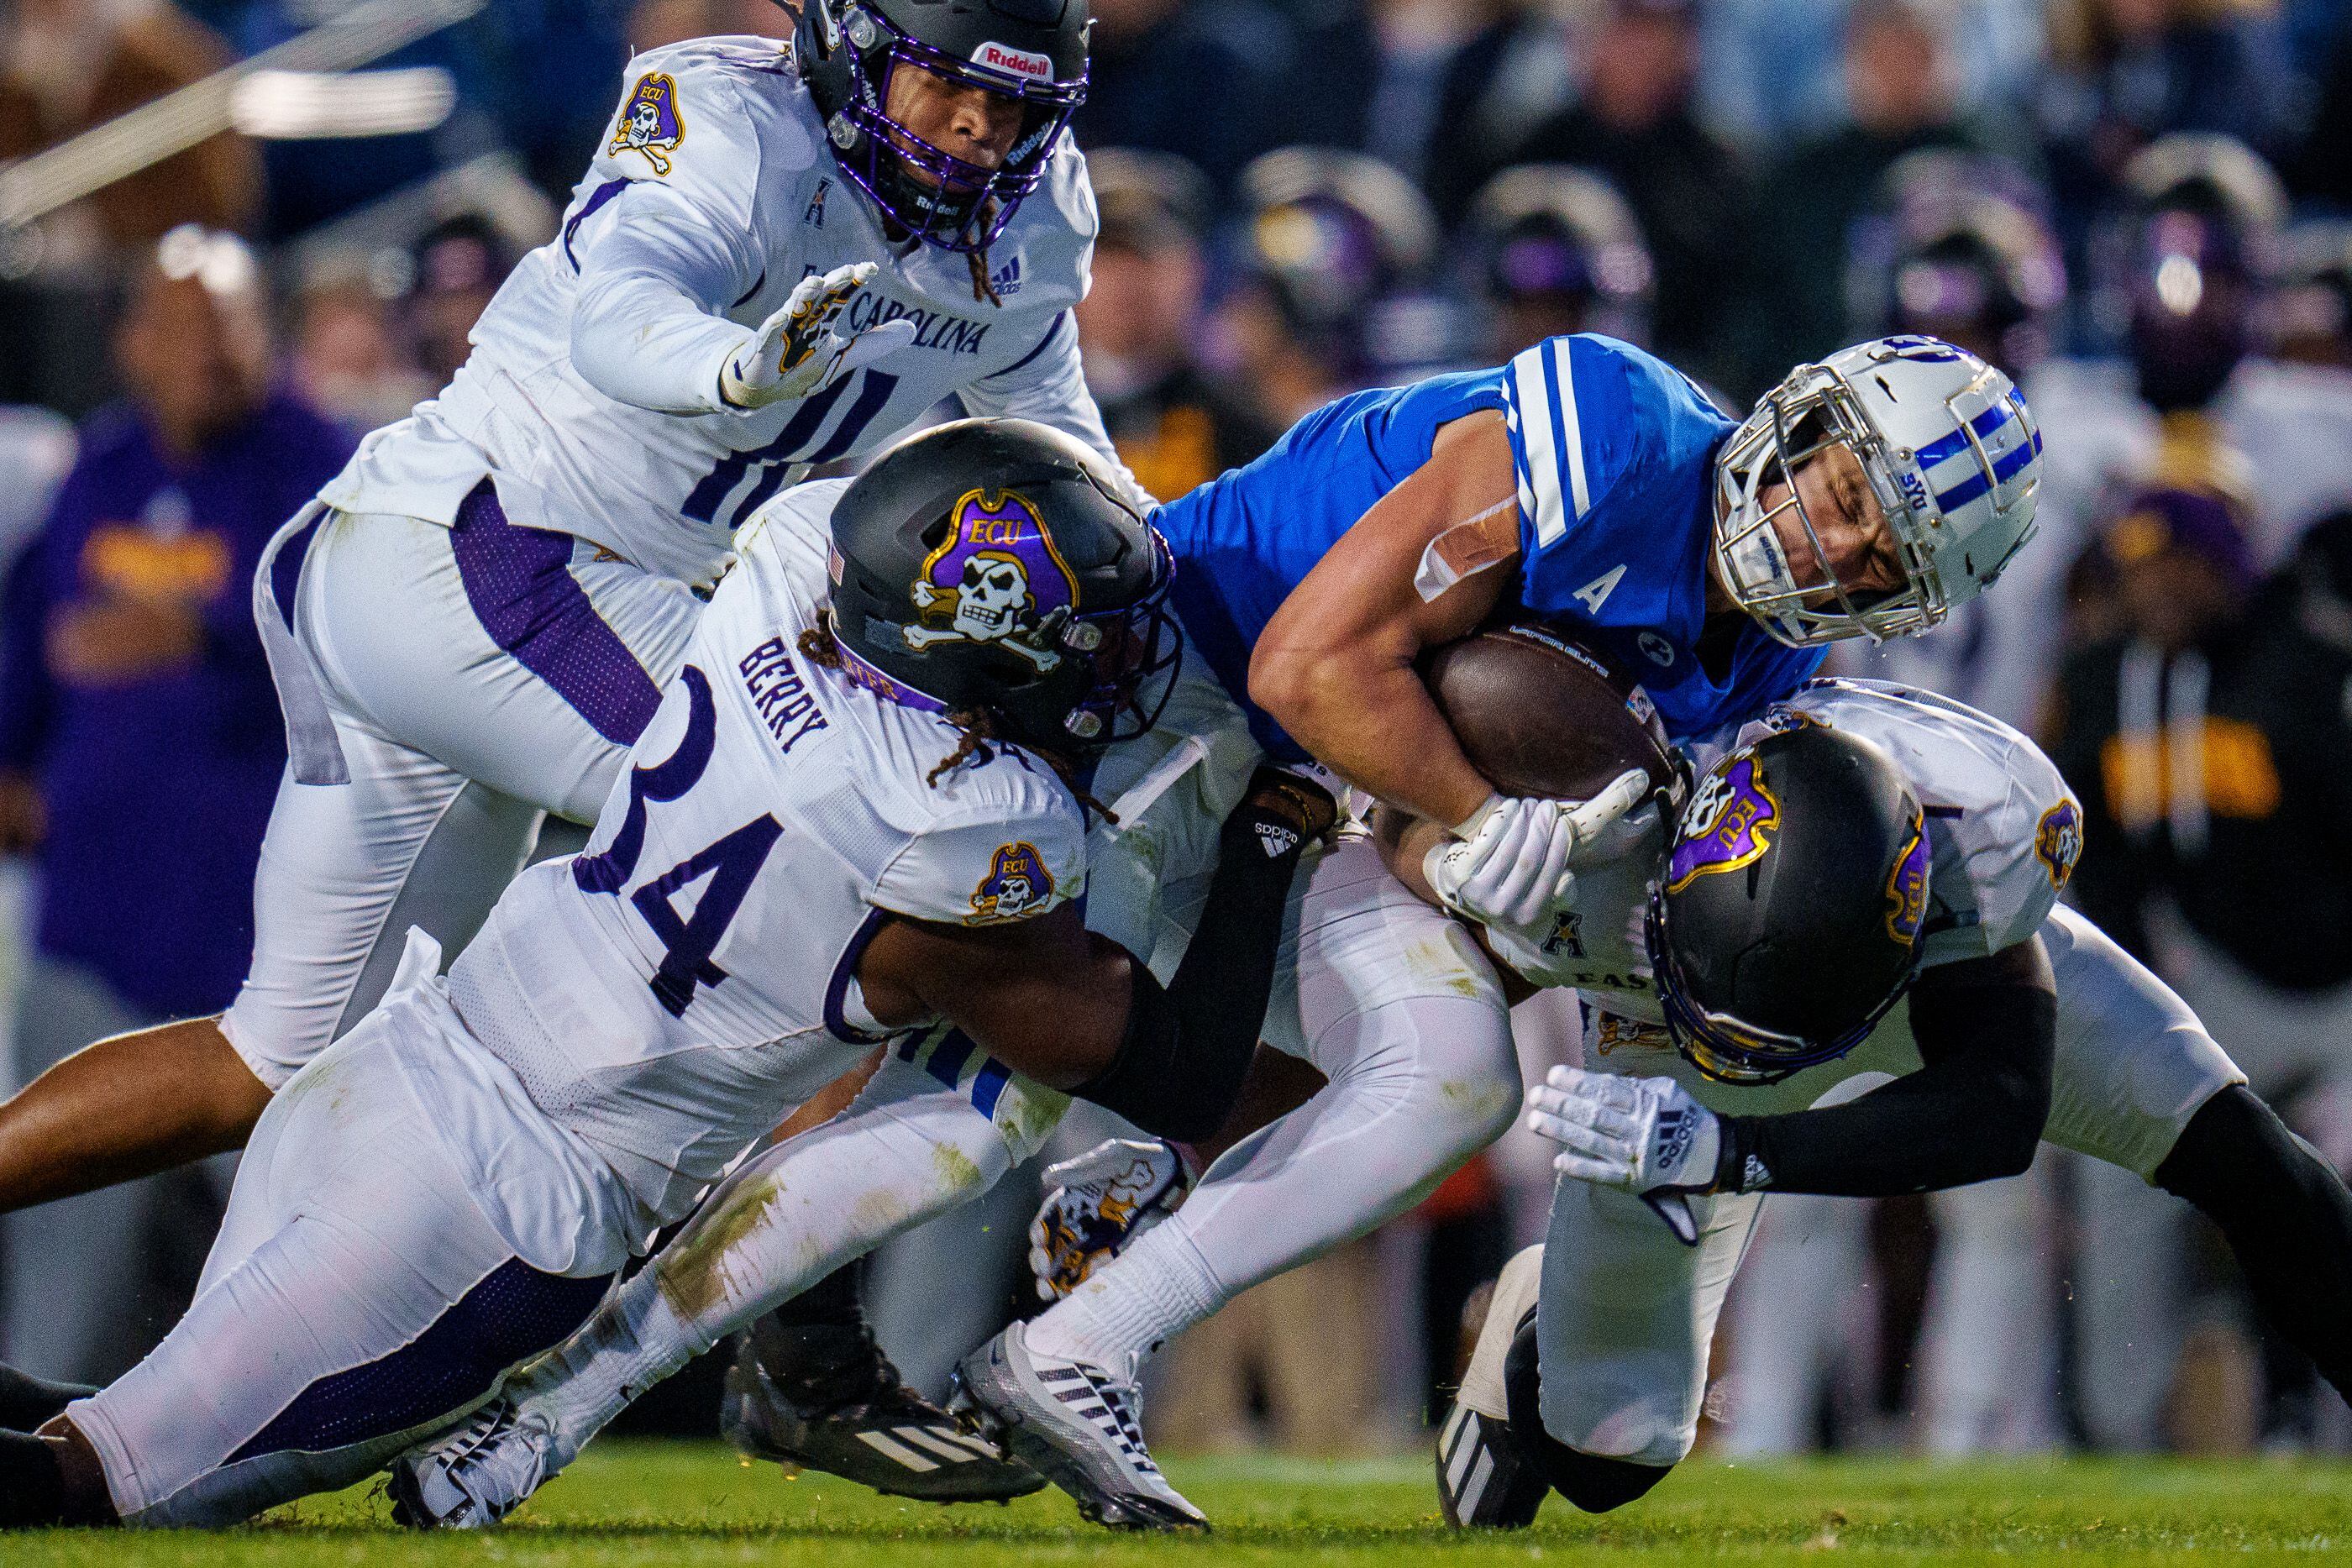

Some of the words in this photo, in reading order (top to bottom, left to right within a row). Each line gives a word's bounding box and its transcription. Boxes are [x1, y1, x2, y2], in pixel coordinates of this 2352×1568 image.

[985, 47, 1049, 76] Riddell
[639, 86, 666, 101] ECU
[916, 195, 960, 216] Ridell
[1900, 472, 1928, 511] BYU
[968, 519, 1023, 545] ECU
[739, 636, 829, 754] BERRY
[1255, 822, 1298, 844] adidas
[1718, 798, 1758, 852] ECU
[571, 663, 785, 1019] 34
[1002, 858, 1029, 873] ECU
[1573, 973, 1649, 989] EAS
